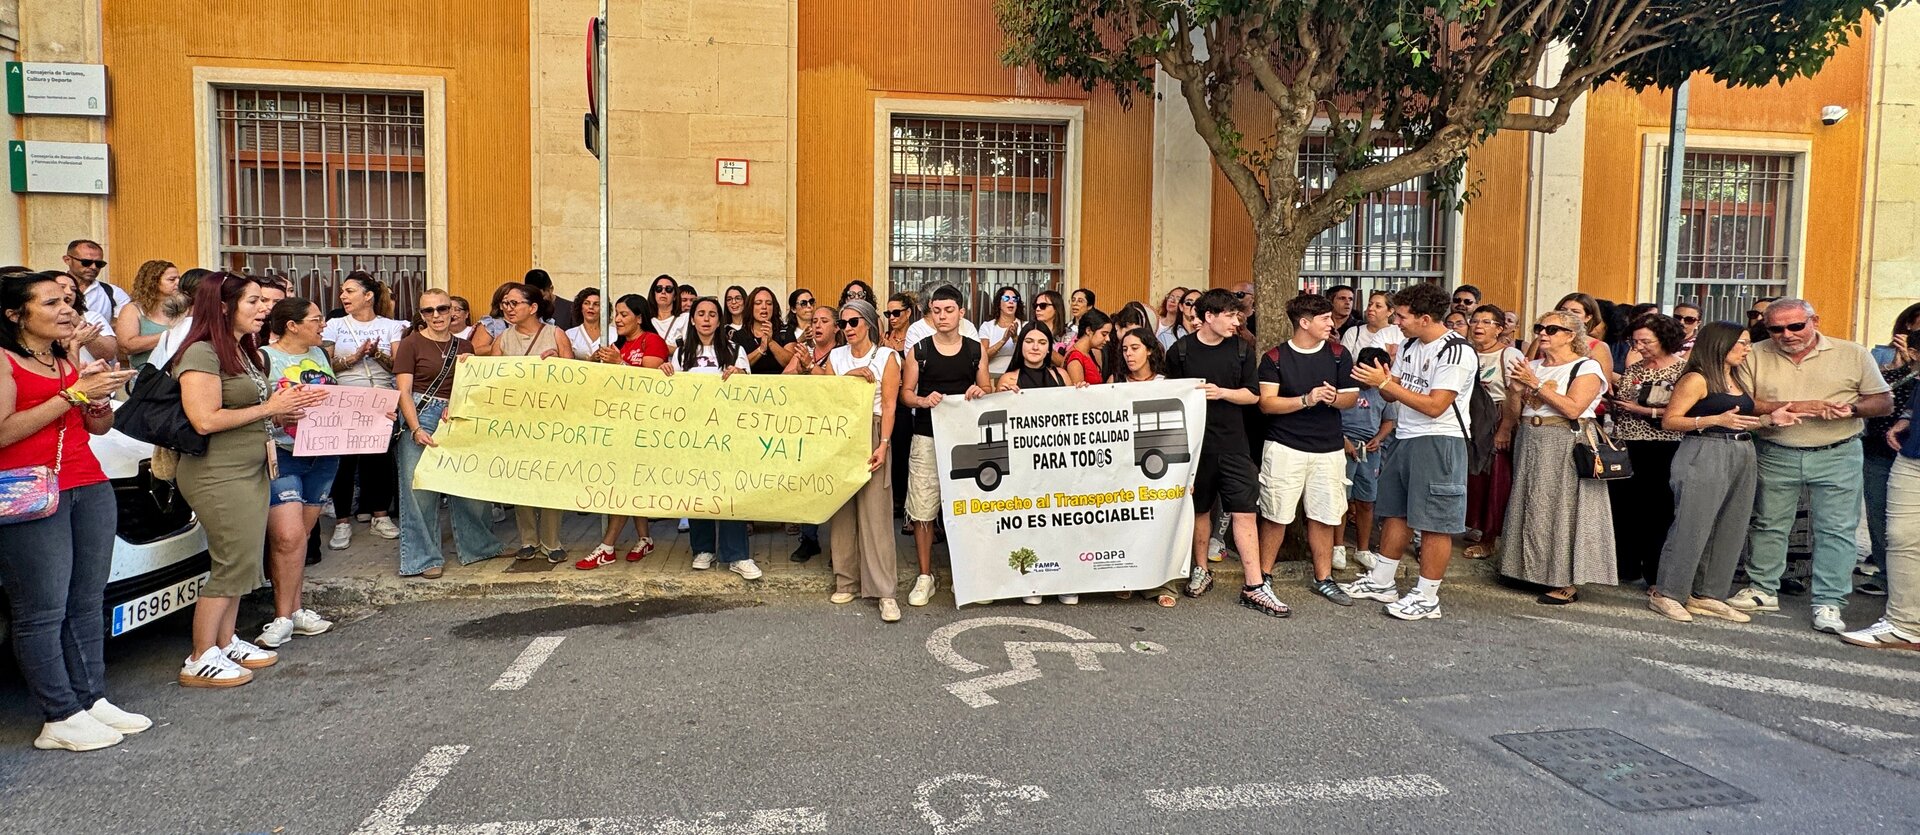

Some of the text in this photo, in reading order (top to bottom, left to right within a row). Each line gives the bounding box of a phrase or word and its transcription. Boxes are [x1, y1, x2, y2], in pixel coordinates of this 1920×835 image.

[604, 373, 675, 397] NIÑOS
[693, 383, 703, 402] Y
[715, 383, 788, 406] NIÑAS
[1400, 370, 1429, 388] mirates
[338, 391, 366, 408] ESTÁ
[372, 393, 387, 408] LA
[462, 384, 569, 411] TIENEN
[593, 399, 687, 423] DERECHO
[705, 408, 720, 427] A
[737, 411, 852, 439] ESTUDIAR.
[351, 410, 374, 427] PARA
[1009, 409, 1129, 430] TRANSPORTE ESCOLAR
[300, 430, 340, 451] NUESTRO
[634, 428, 732, 452] ESCOLAR
[758, 436, 803, 462] YA!
[1013, 429, 1130, 449] EDUCACIÓN DE CALIDAD
[1033, 448, 1112, 470] PARA TOD@S
[488, 455, 616, 486] QUEREMOS
[633, 463, 726, 494] EXCUSAS,
[735, 469, 834, 496] QUEREMOS
[576, 485, 735, 516] SOLUCIONES!
[953, 484, 1186, 516] El Derecho al Transporte Escola
[996, 507, 1155, 534] ¡NO ES NEGOCIABLE!
[1034, 561, 1060, 569] FAMPA
[128, 591, 171, 626] 1696
